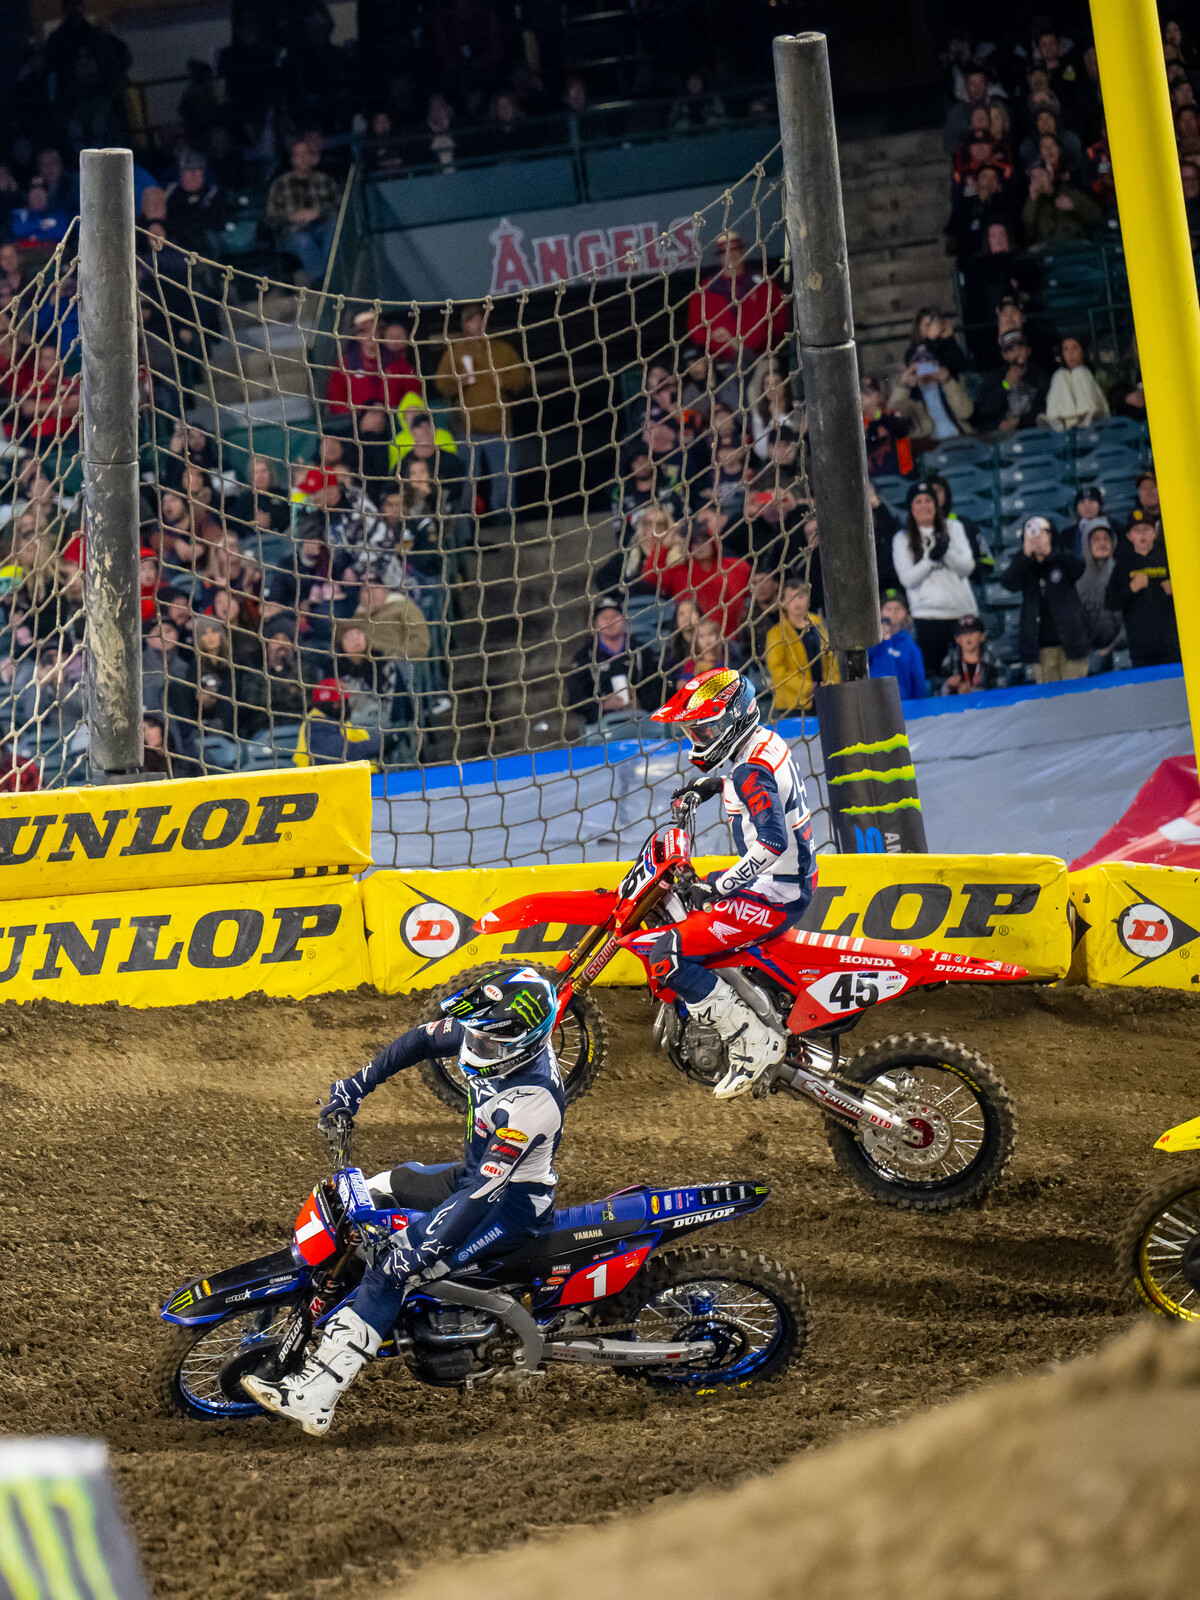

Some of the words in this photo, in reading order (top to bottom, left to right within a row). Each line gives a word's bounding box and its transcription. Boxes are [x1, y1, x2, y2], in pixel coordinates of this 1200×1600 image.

[489, 216, 698, 295] ANGELS
[412, 920, 455, 941] D
[1127, 919, 1169, 942] D
[587, 938, 617, 980] SHOWA
[839, 955, 895, 967] HONDA
[934, 964, 995, 976] DUNLOP
[829, 973, 879, 1009] 45
[942, 1063, 982, 1093] DUNLOP
[484, 1165, 502, 1175] BELL
[295, 1210, 325, 1245] 1
[394, 1217, 406, 1227] 1
[673, 1207, 735, 1229] DUNLOP
[467, 1226, 503, 1255] YAMAHA
[573, 1229, 603, 1240] YAMAHA
[586, 1264, 607, 1298] 1
[279, 1317, 303, 1364] DUNLOP
[592, 1353, 628, 1361] YAMALUBE
